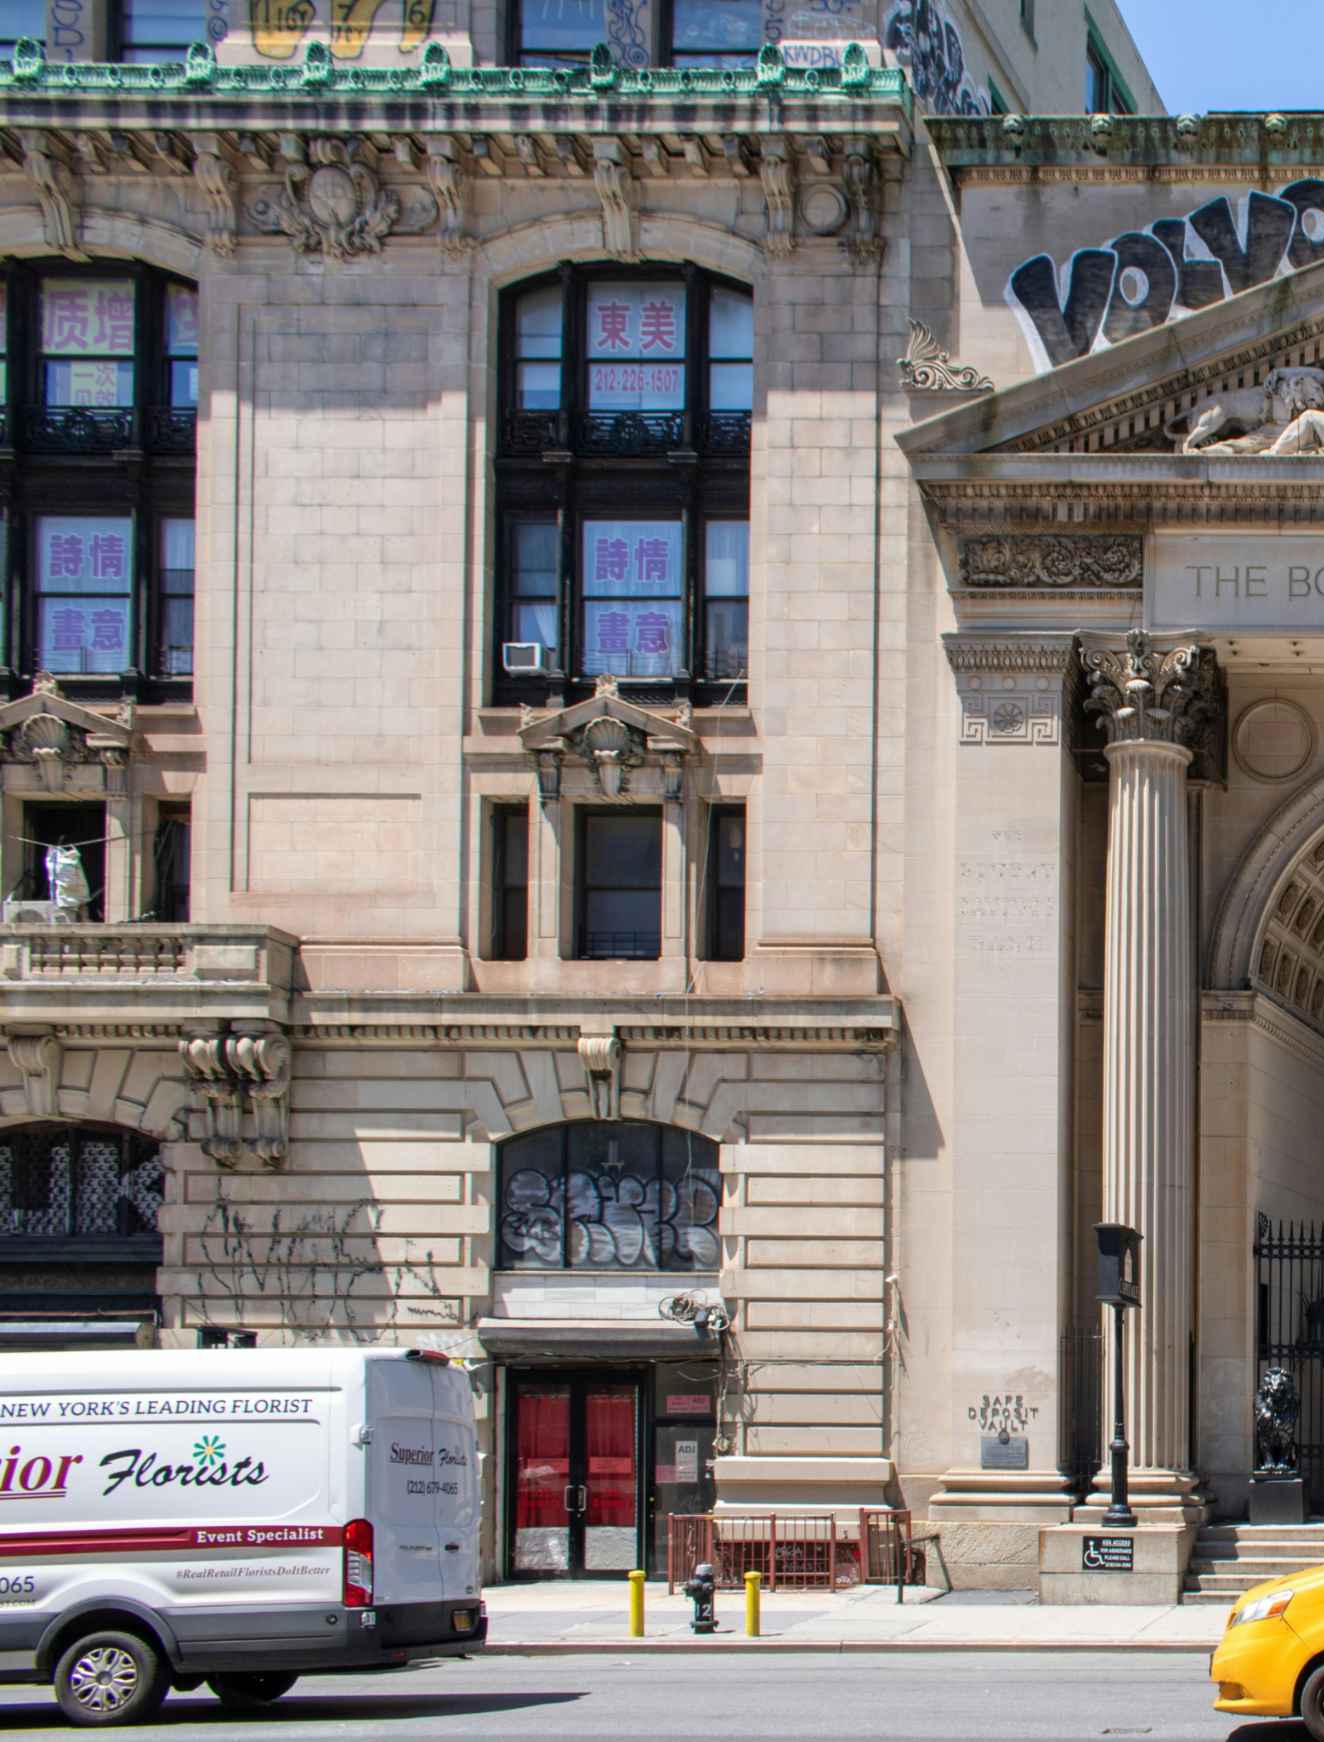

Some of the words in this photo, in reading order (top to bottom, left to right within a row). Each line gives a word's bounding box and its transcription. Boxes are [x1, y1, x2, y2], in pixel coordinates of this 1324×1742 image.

[596, 301, 675, 350] 東美
[50, 534, 125, 578] 詩情
[596, 538, 669, 580] 詩情
[1188, 564, 1267, 598] THE
[51, 608, 125, 651] 畫意
[597, 611, 669, 654] 畫意
[1, 1403, 50, 1417] NEW
[58, 1401, 130, 1416] YORK'S
[136, 1400, 227, 1415] LEADING
[231, 1399, 312, 1414] FLORIST
[968, 1408, 1039, 1421] DEPOSIT
[982, 1395, 1024, 1409] SAFE
[979, 1419, 1028, 1432] VAULT
[390, 1441, 434, 1465] Superior
[100, 1449, 269, 1496] Florists
[197, 1530, 242, 1544] Event
[247, 1528, 324, 1543] Specialist
[177, 1566, 331, 1581] #RealRetailFloristsDoItBetter
